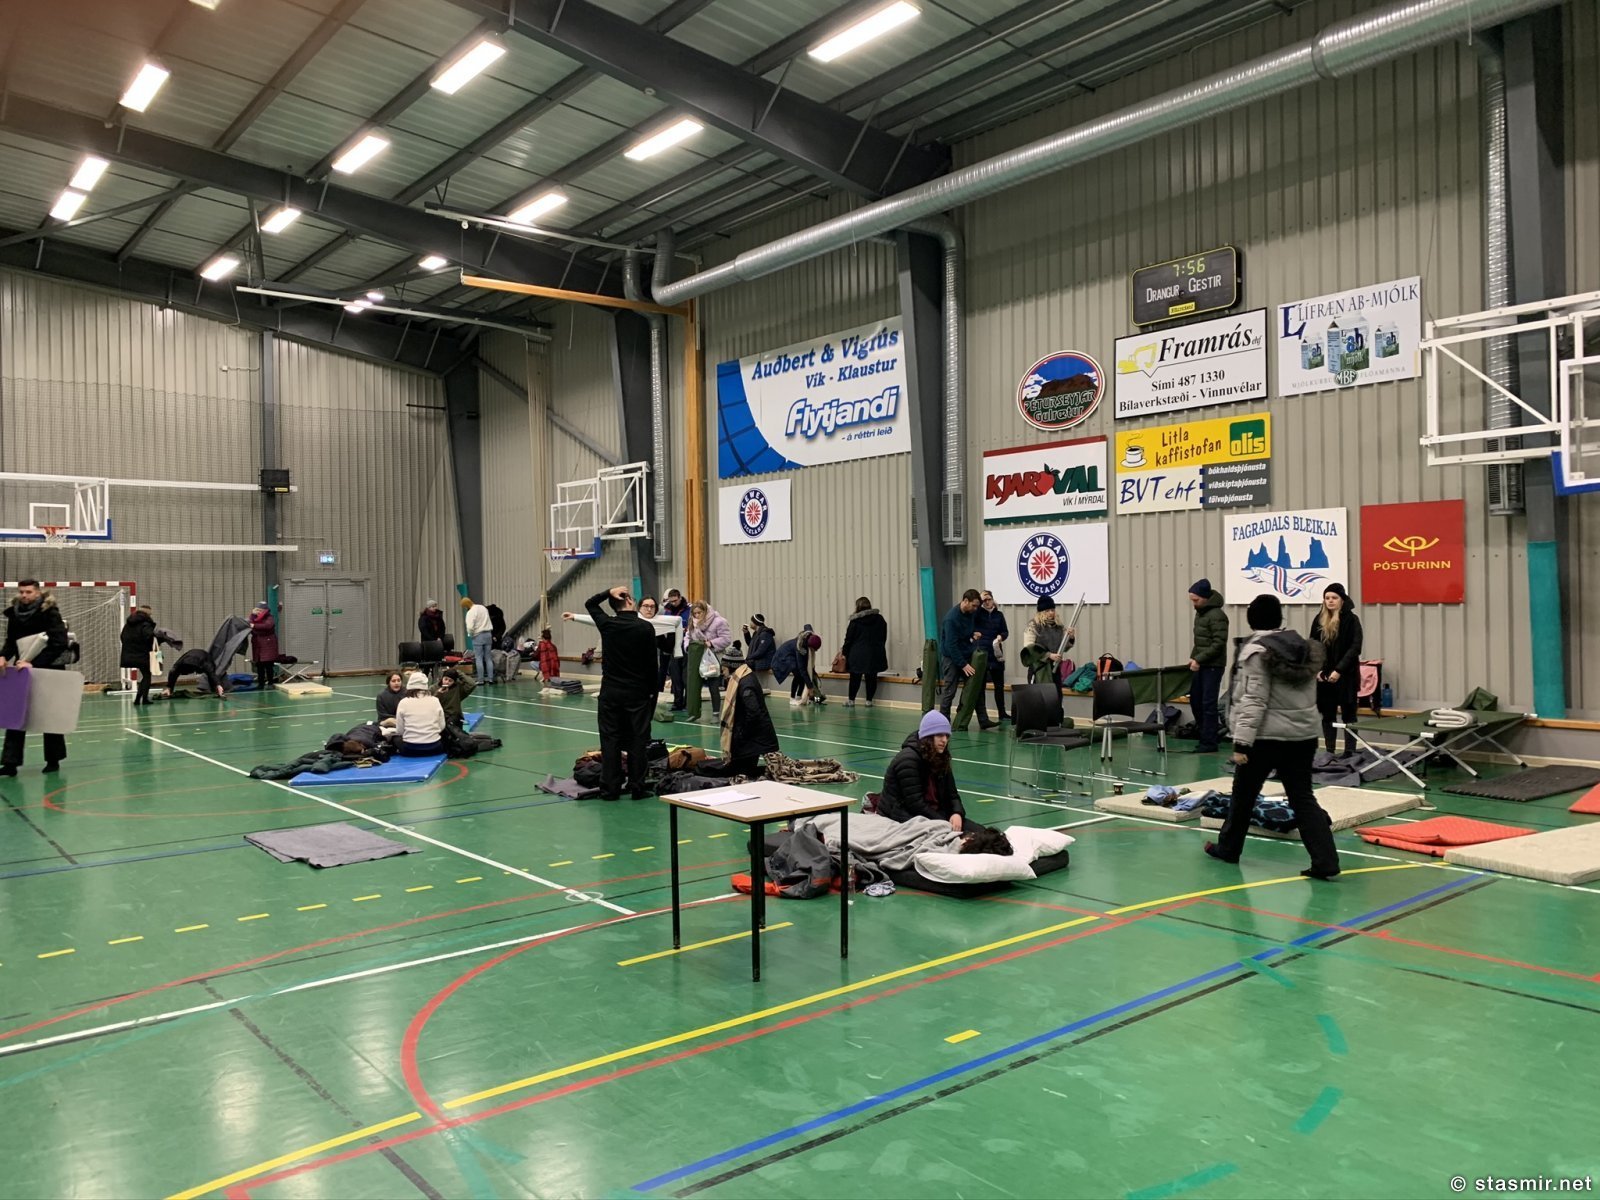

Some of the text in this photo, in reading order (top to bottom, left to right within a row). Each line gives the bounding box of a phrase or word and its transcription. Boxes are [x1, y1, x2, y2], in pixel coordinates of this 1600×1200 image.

[1173, 258, 1205, 277] 7:56
[1349, 284, 1418, 311] AB-MJÓLK
[1158, 323, 1252, 362] Framrás
[752, 349, 815, 380] Auðbert
[821, 343, 834, 364] &
[806, 372, 825, 388] Vík
[838, 358, 897, 382] Klaustur
[1152, 370, 1225, 392] Sími 487 1330
[1336, 370, 1357, 385] MBF
[1119, 391, 1189, 412] Bílaverkstæði
[1200, 380, 1262, 399] Vinnuvélar
[785, 386, 900, 439] Flytjandi
[1162, 427, 1189, 448] Litla
[1230, 432, 1265, 455] olís
[1156, 438, 1222, 467] kaffistofan
[1078, 495, 1105, 504] MÝRDAL
[1120, 476, 1196, 505] BVT ehf
[1232, 516, 1338, 541] FAGRADALS BLEIKJA
[1020, 536, 1067, 566] ICEWEAR
[1373, 561, 1451, 571] PÓSTURINN
[1026, 580, 1060, 593] ICELAND
